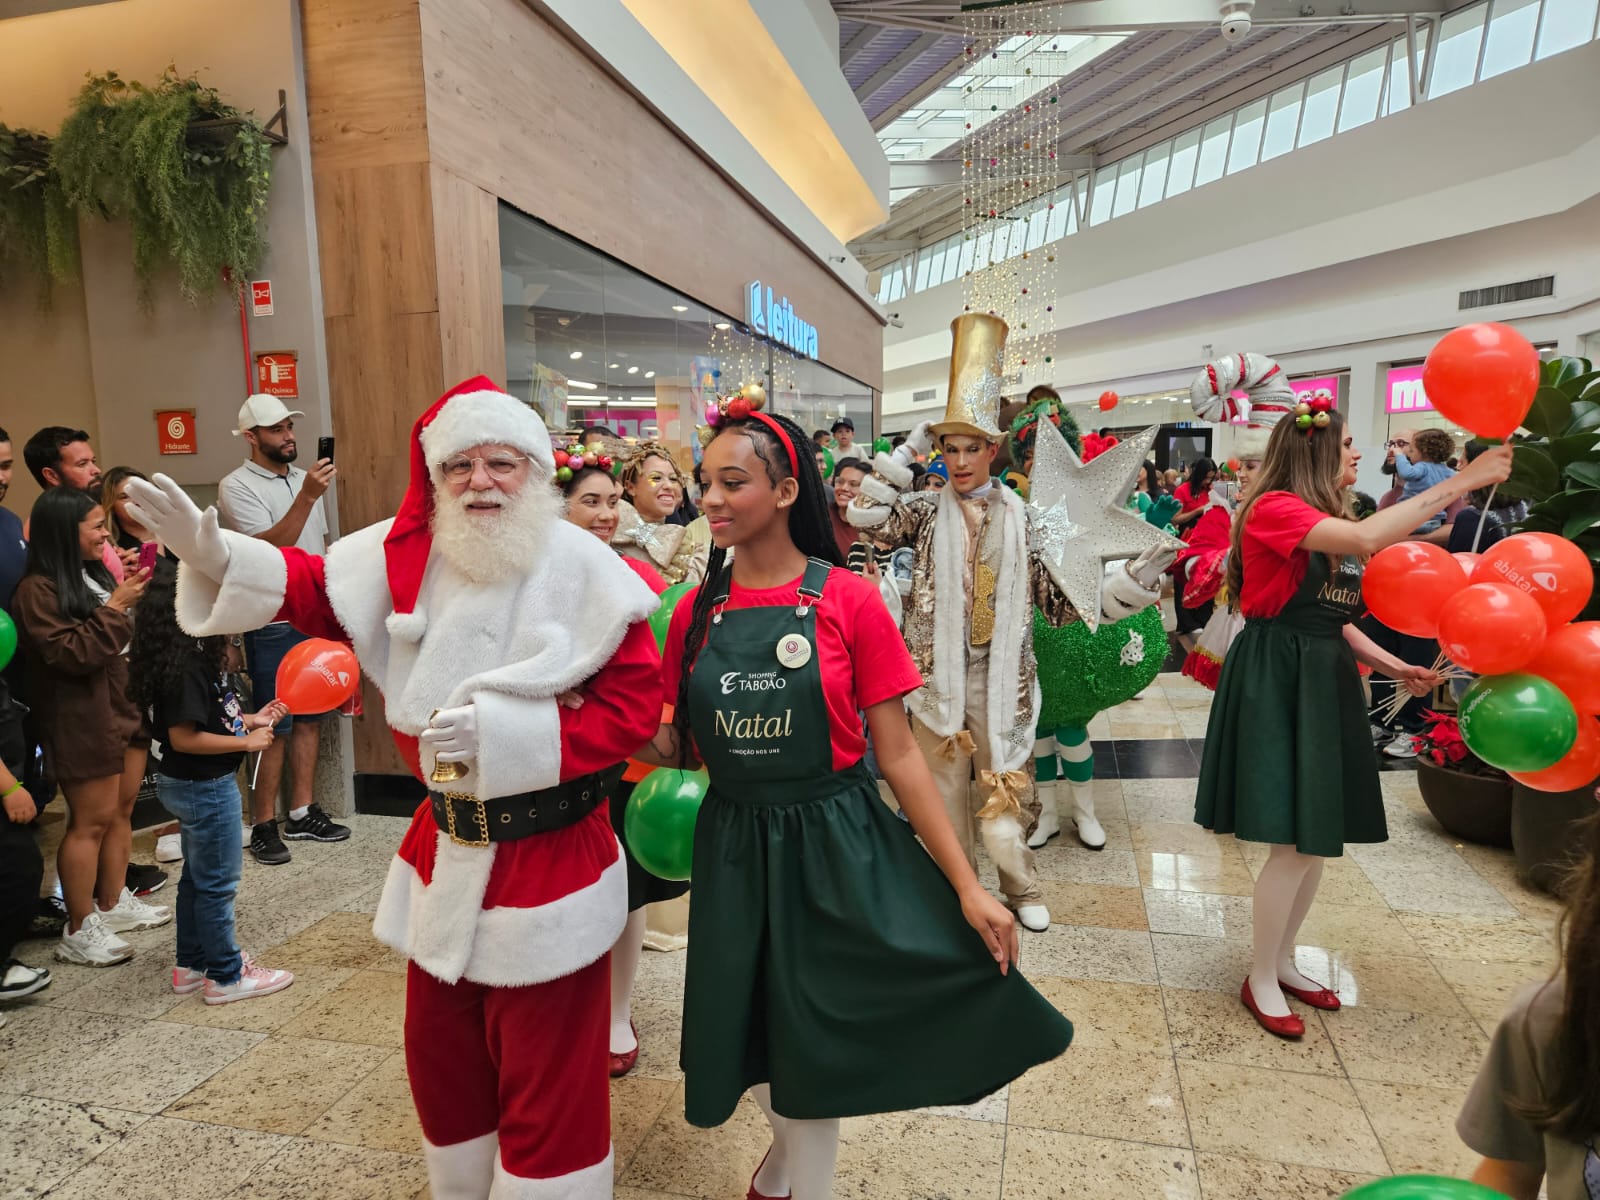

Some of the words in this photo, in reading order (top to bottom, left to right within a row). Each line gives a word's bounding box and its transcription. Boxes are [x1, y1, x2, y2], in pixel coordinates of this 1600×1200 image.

[766, 286, 818, 360] leitura
[1494, 559, 1539, 594] abiatar
[1317, 581, 1361, 606] Natal
[714, 708, 793, 739] Natal
